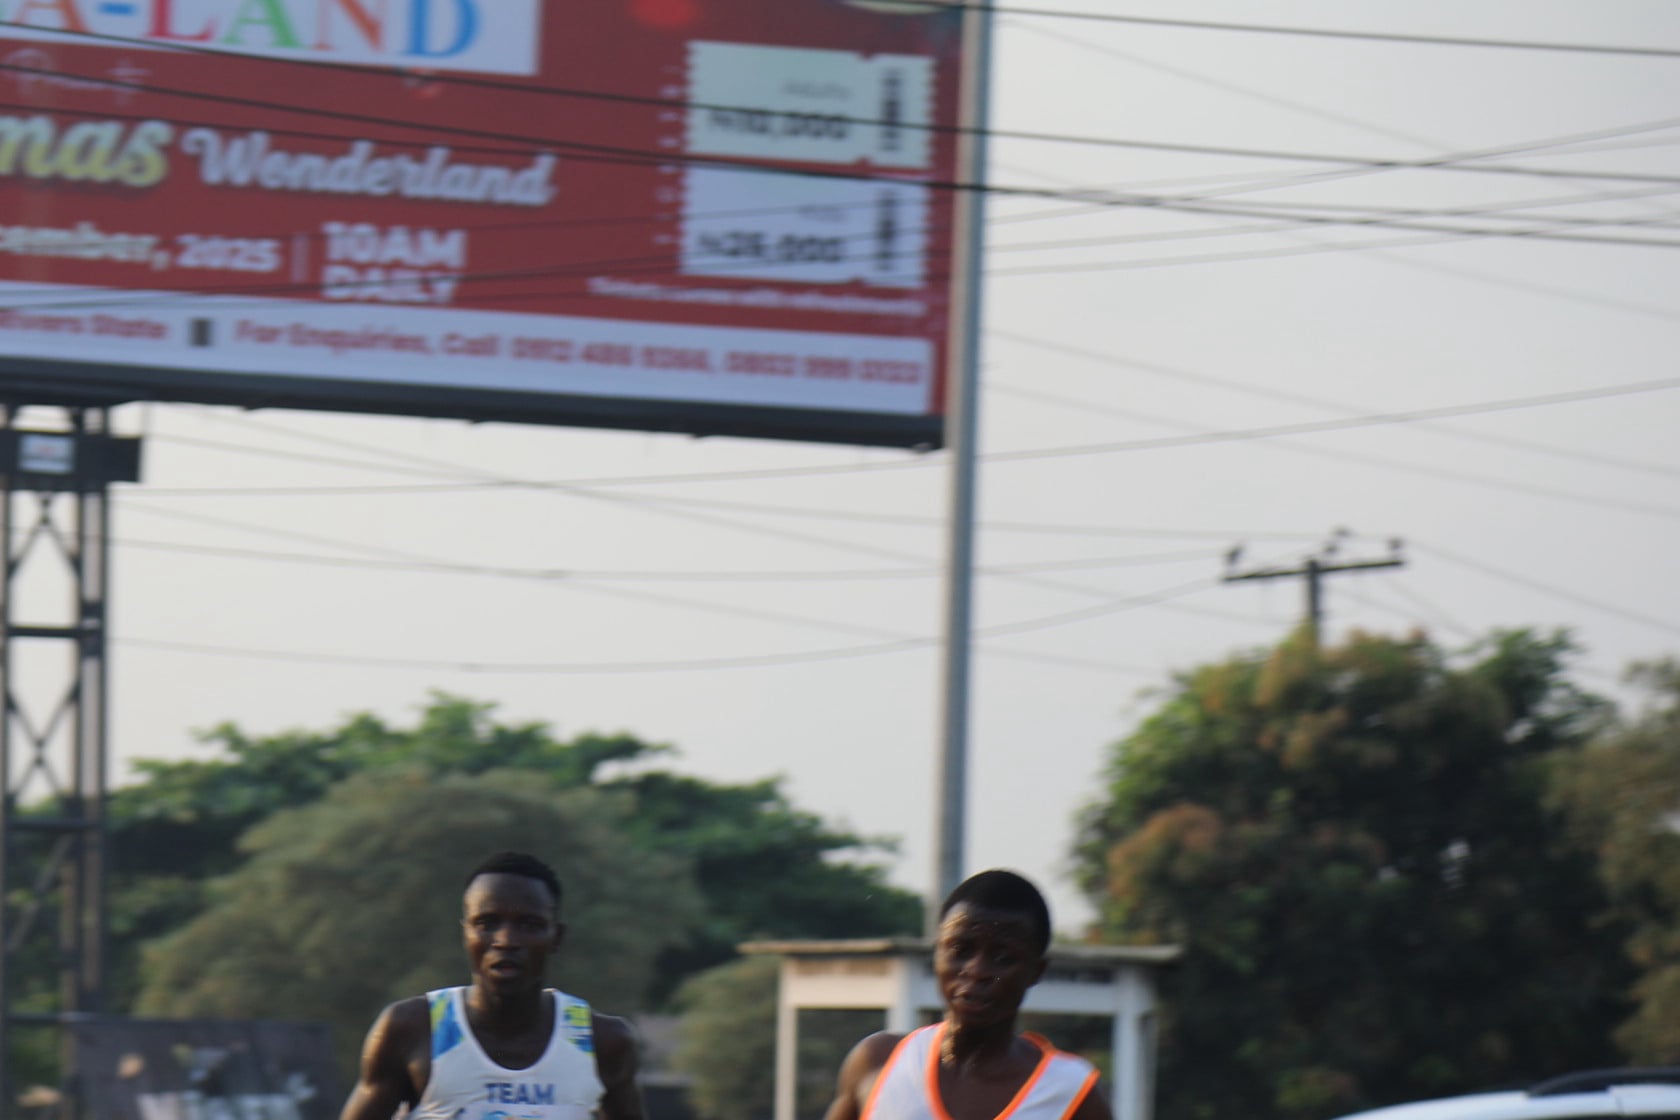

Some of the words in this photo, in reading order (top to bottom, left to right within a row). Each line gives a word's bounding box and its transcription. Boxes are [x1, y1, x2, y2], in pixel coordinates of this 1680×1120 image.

[182, 128, 558, 206] Wonderland
[321, 220, 468, 270] 10AM
[322, 264, 460, 304] DAILY
[483, 1081, 556, 1105] TEAM
